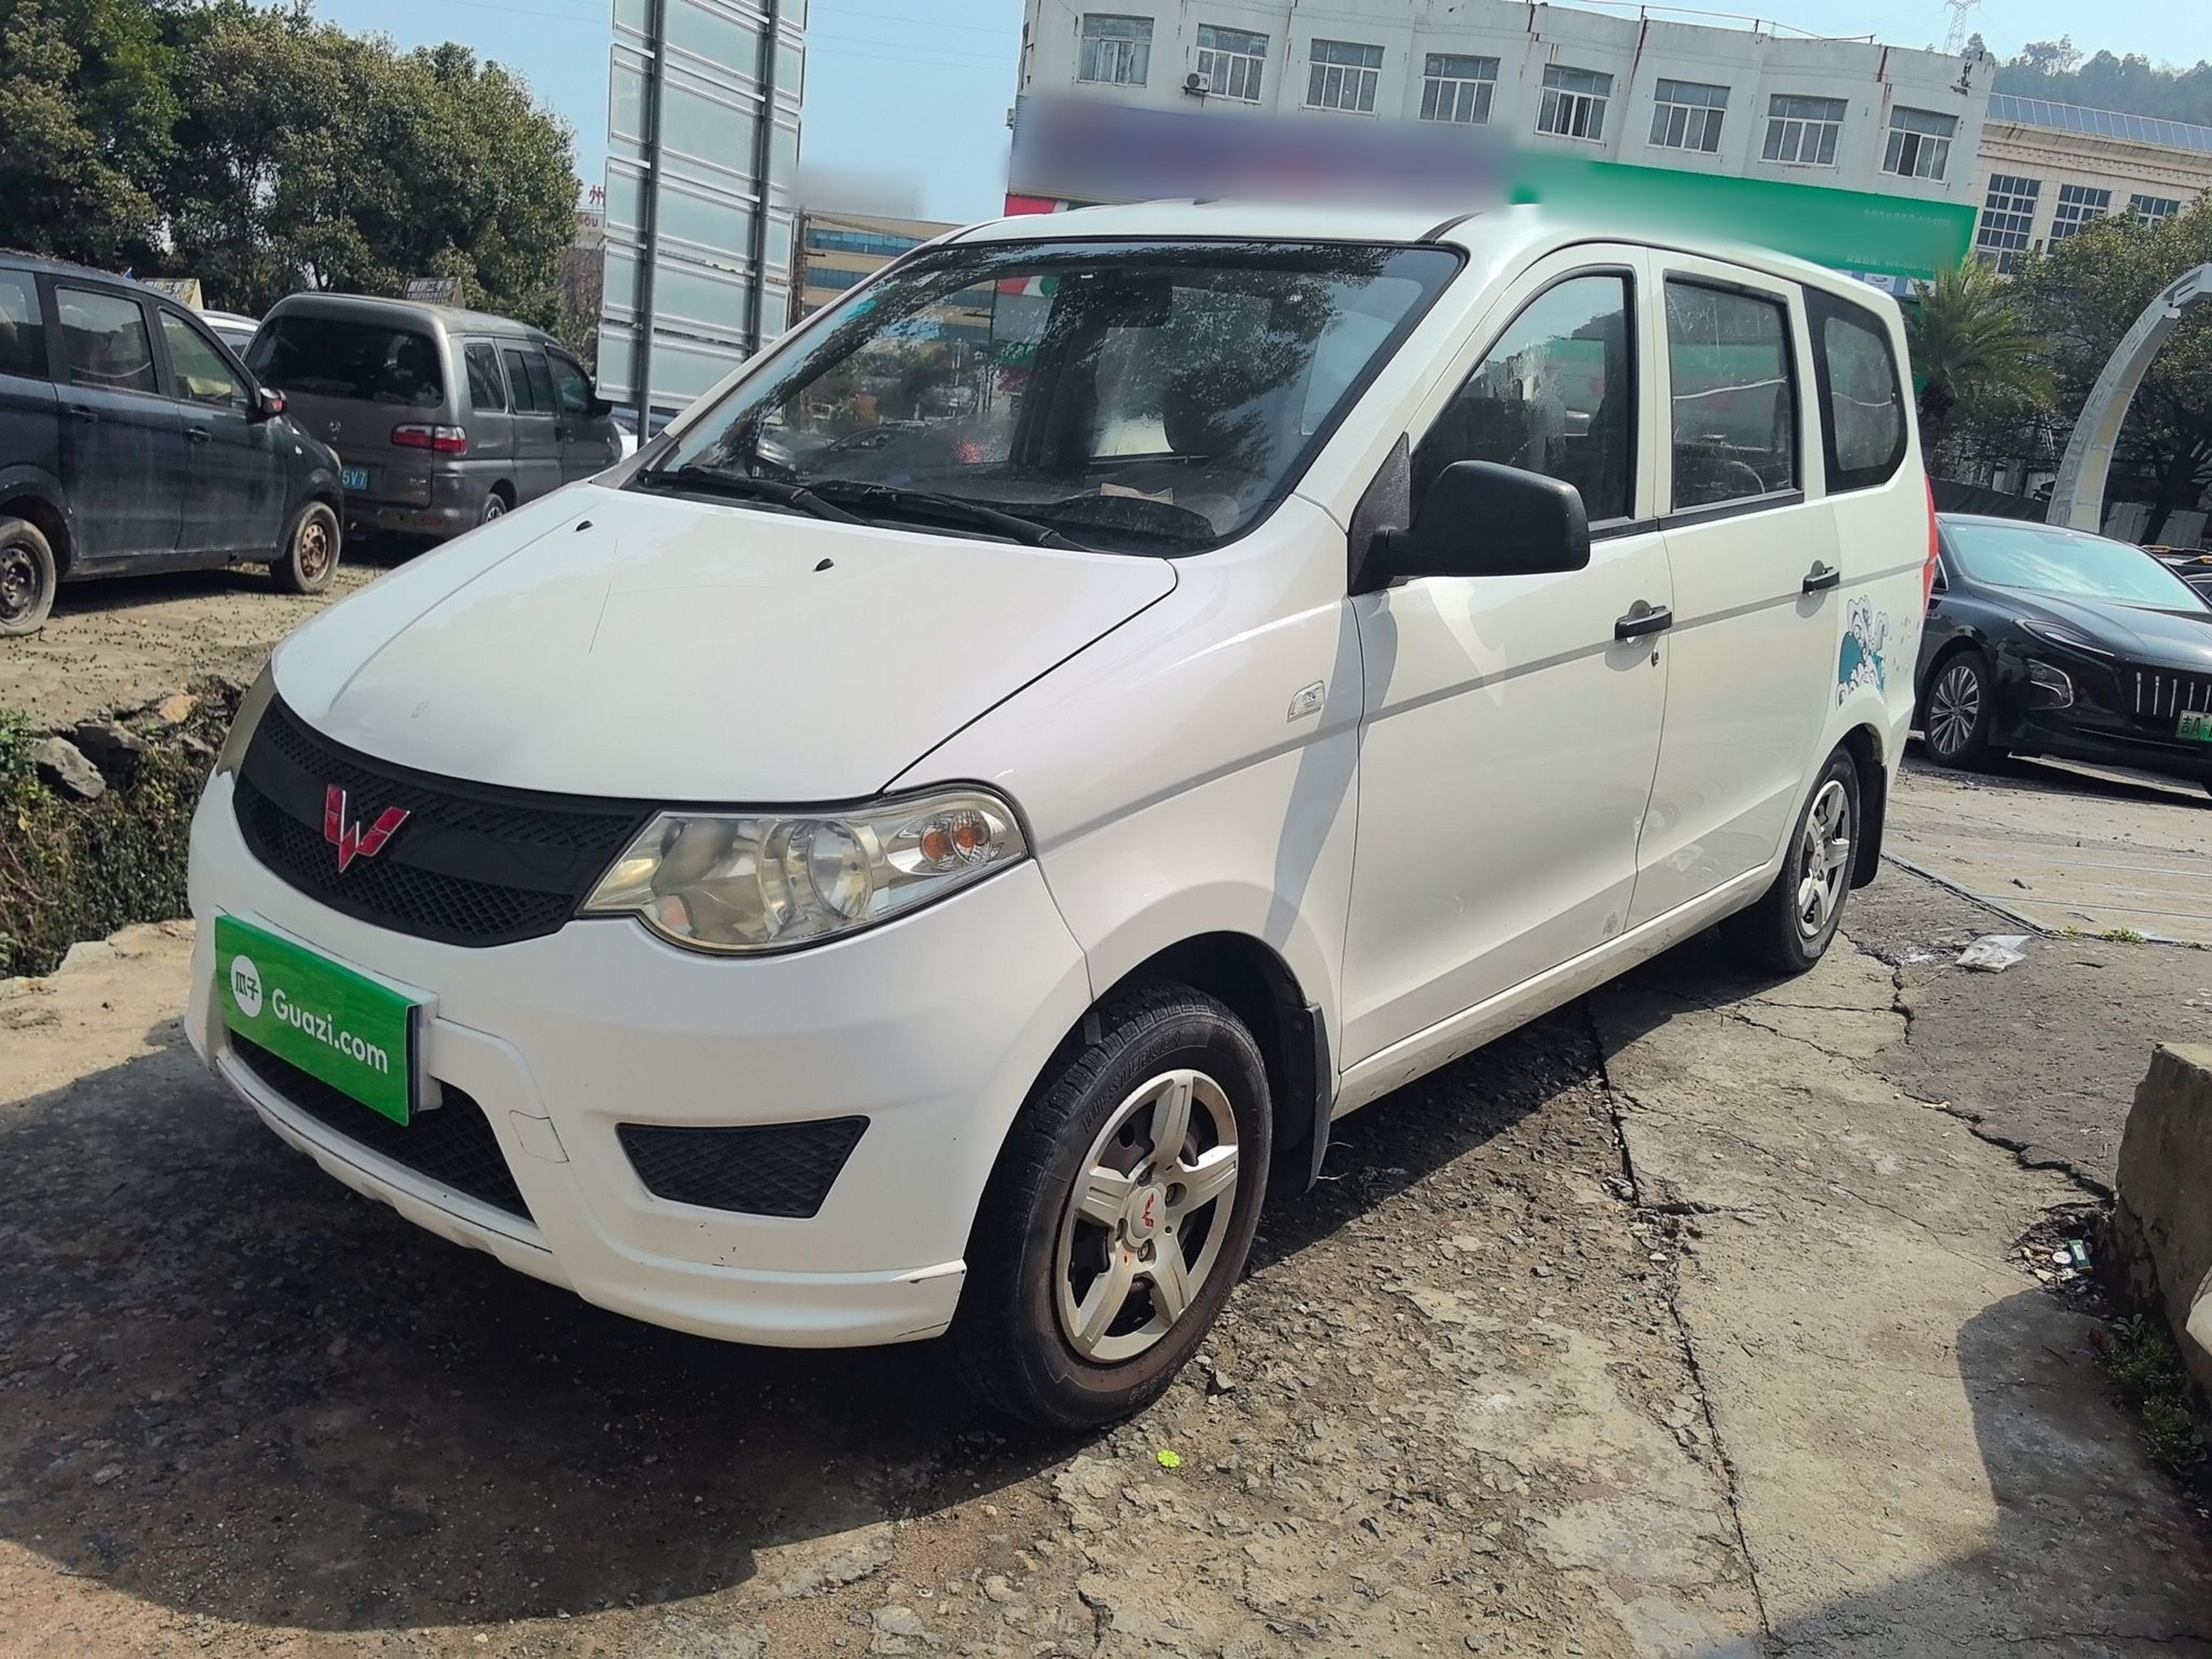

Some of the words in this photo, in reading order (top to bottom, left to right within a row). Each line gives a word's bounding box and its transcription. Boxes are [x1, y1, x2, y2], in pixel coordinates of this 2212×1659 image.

[589, 185, 605, 207] 州
[236, 971, 259, 1001] 瓜子
[271, 988, 389, 1074] Guazi.com
